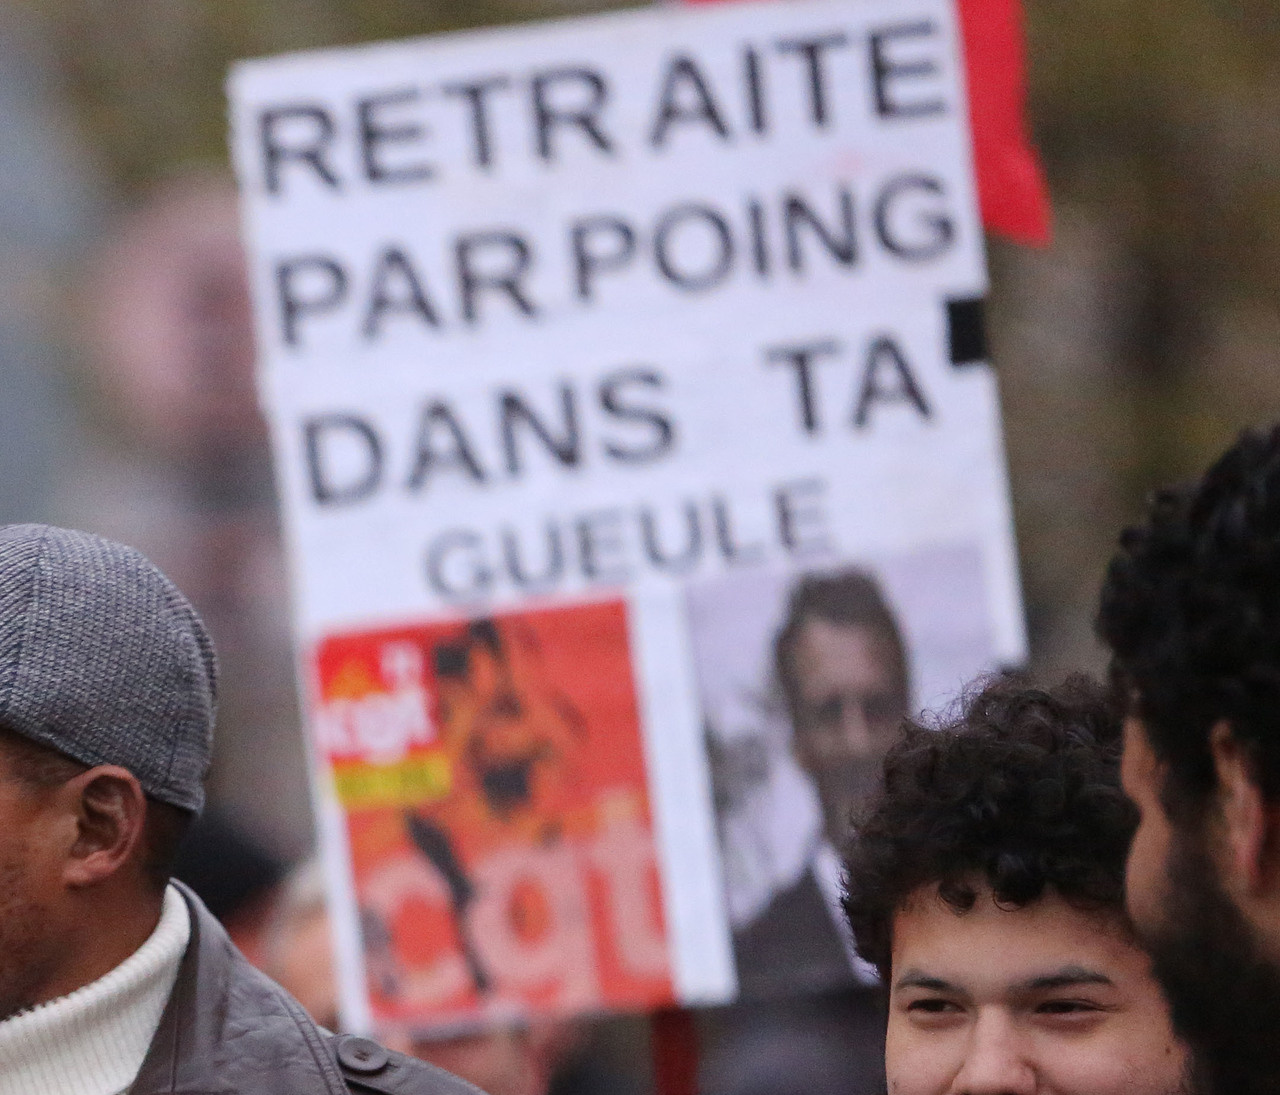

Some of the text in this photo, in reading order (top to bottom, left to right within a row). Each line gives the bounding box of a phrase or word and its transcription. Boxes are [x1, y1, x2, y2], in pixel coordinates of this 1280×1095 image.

[257, 19, 949, 197] RETRAITE
[275, 170, 957, 349] PAR POING
[300, 332, 935, 508] DANS TA
[423, 477, 834, 602] GUEULE
